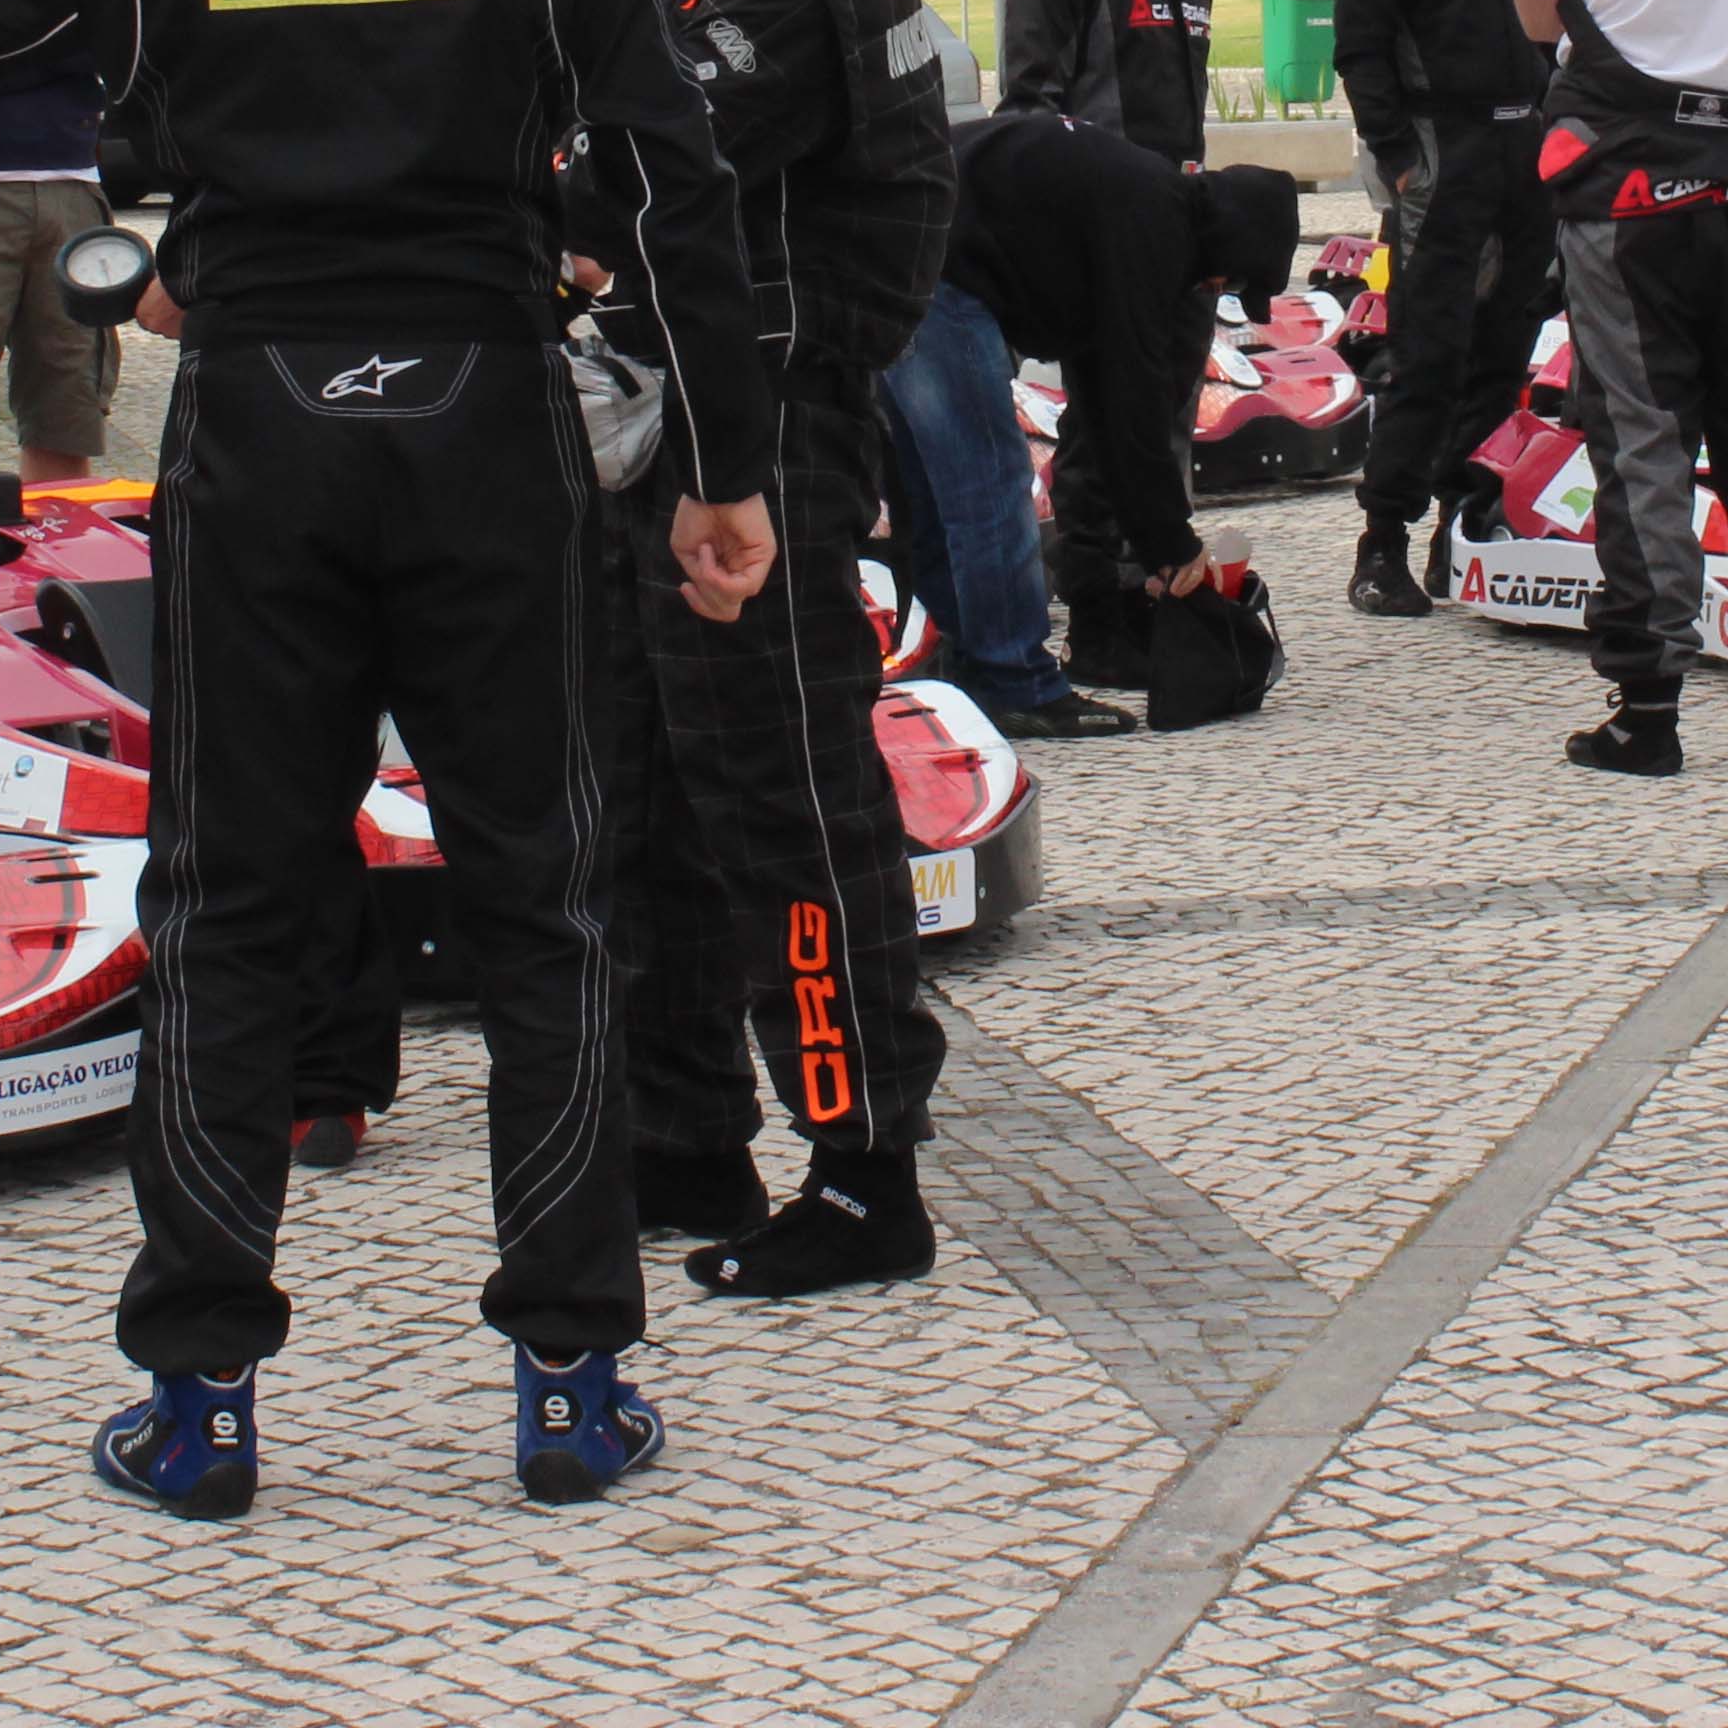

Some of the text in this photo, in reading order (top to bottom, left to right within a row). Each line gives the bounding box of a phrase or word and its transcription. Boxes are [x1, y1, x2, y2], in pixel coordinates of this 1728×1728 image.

[912, 859, 957, 903] AM
[788, 900, 852, 1124] CRG
[1, 1094, 88, 1120] TRANSPORTES
[819, 1185, 868, 1220] sparco
